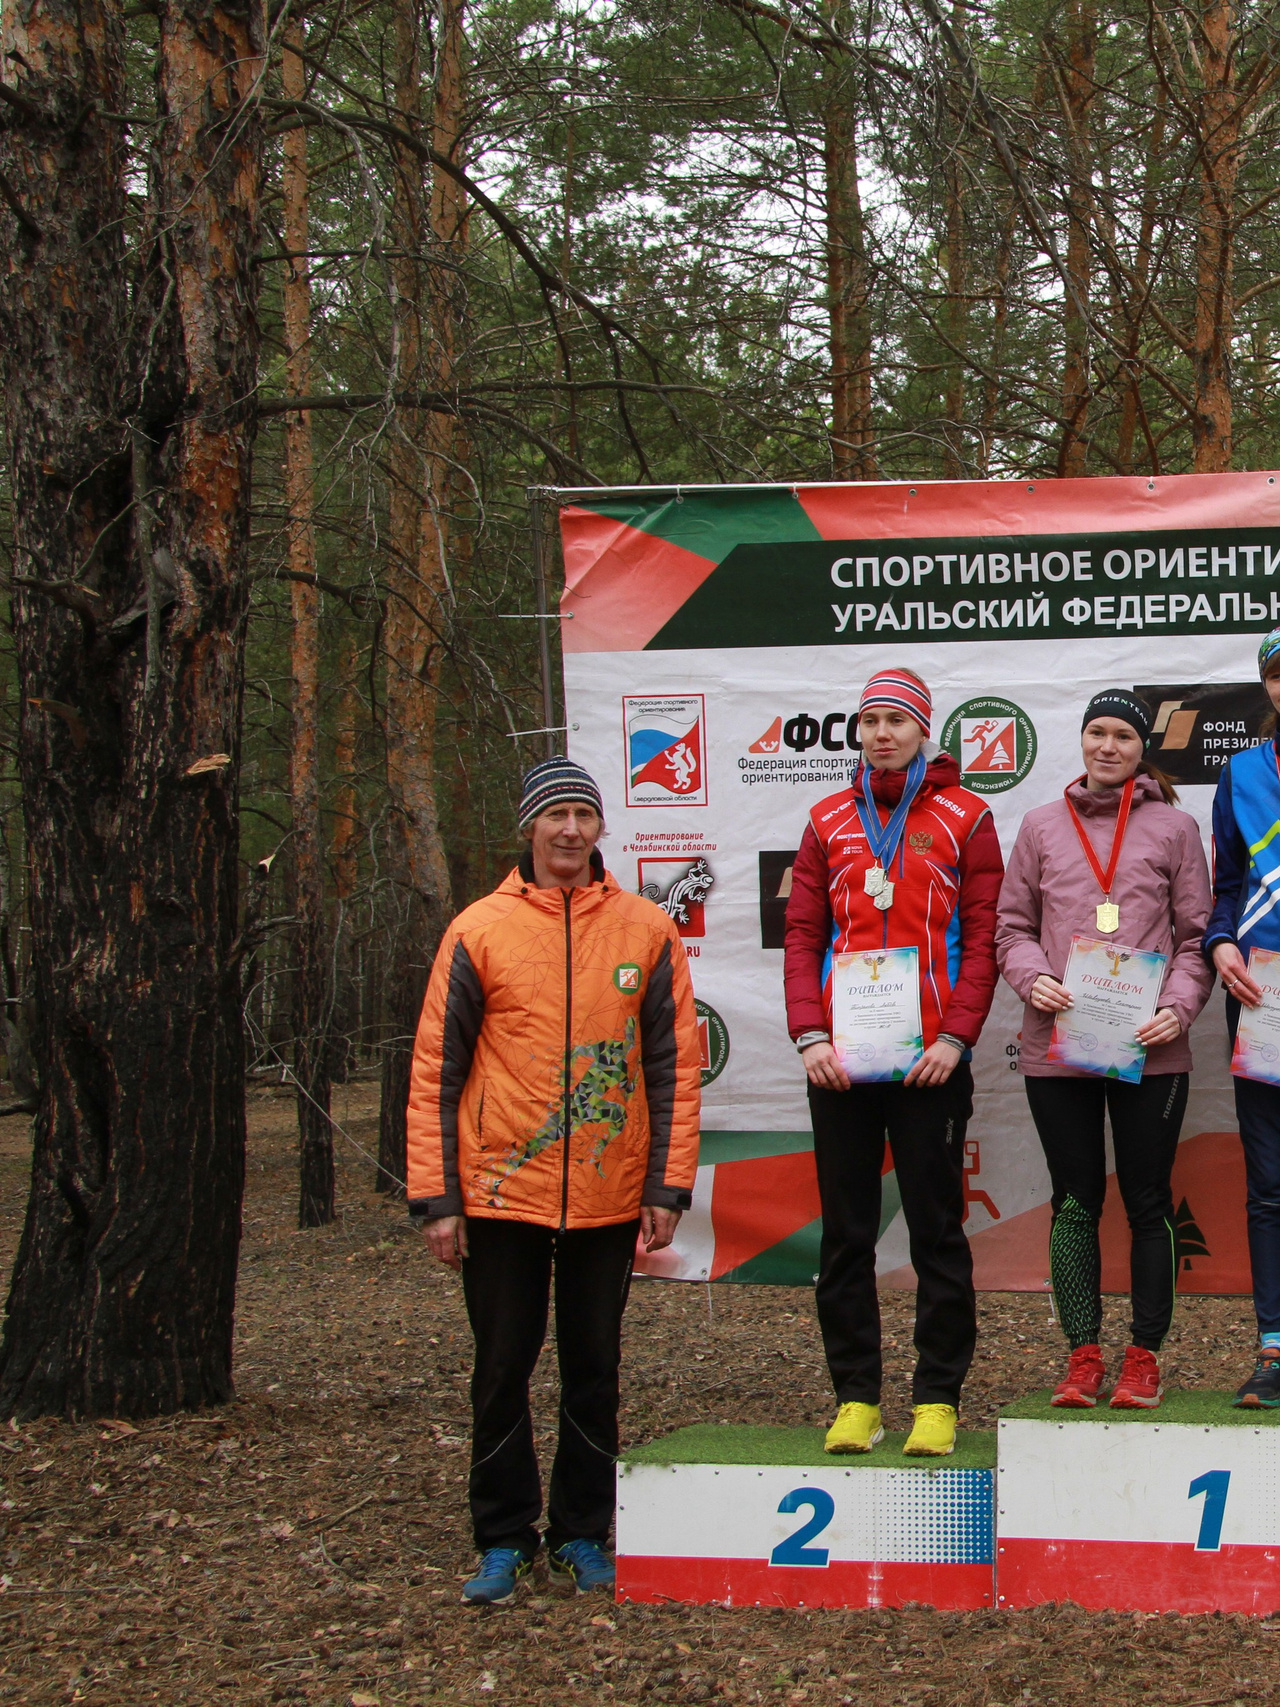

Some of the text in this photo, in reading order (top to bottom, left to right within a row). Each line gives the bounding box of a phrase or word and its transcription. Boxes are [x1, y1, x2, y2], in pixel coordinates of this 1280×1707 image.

[831, 551, 1094, 589] СПОРТИВНОЕ
[831, 591, 1050, 632] УРАЛЬСКИЙ
[628, 700, 662, 708] Федерация
[1203, 721, 1246, 733] ФОНД
[944, 710, 966, 747] ФЕДЕРАЦИЯ
[969, 701, 1018, 716] СПОРТИВНОГО
[1016, 717, 1033, 777] ОРИЕНТИРОВАНИЯ
[1203, 737, 1273, 749] ПРЕЗИДЕ
[738, 757, 806, 772] Федерация
[1203, 754, 1233, 766] ГРА
[741, 772, 844, 786] ориентирования
[932, 794, 967, 818] RUSSIA
[635, 832, 704, 842] Ориентирование
[630, 842, 680, 852] Челябинской
[682, 842, 717, 851] области
[847, 983, 904, 996] ДИПЛОМ
[1080, 974, 1144, 994] ДИПЛОМ
[710, 1016, 726, 1075] ОРИЕНТИРОВАНИЯ
[1187, 1470, 1231, 1551] 1
[769, 1486, 835, 1567] 2
